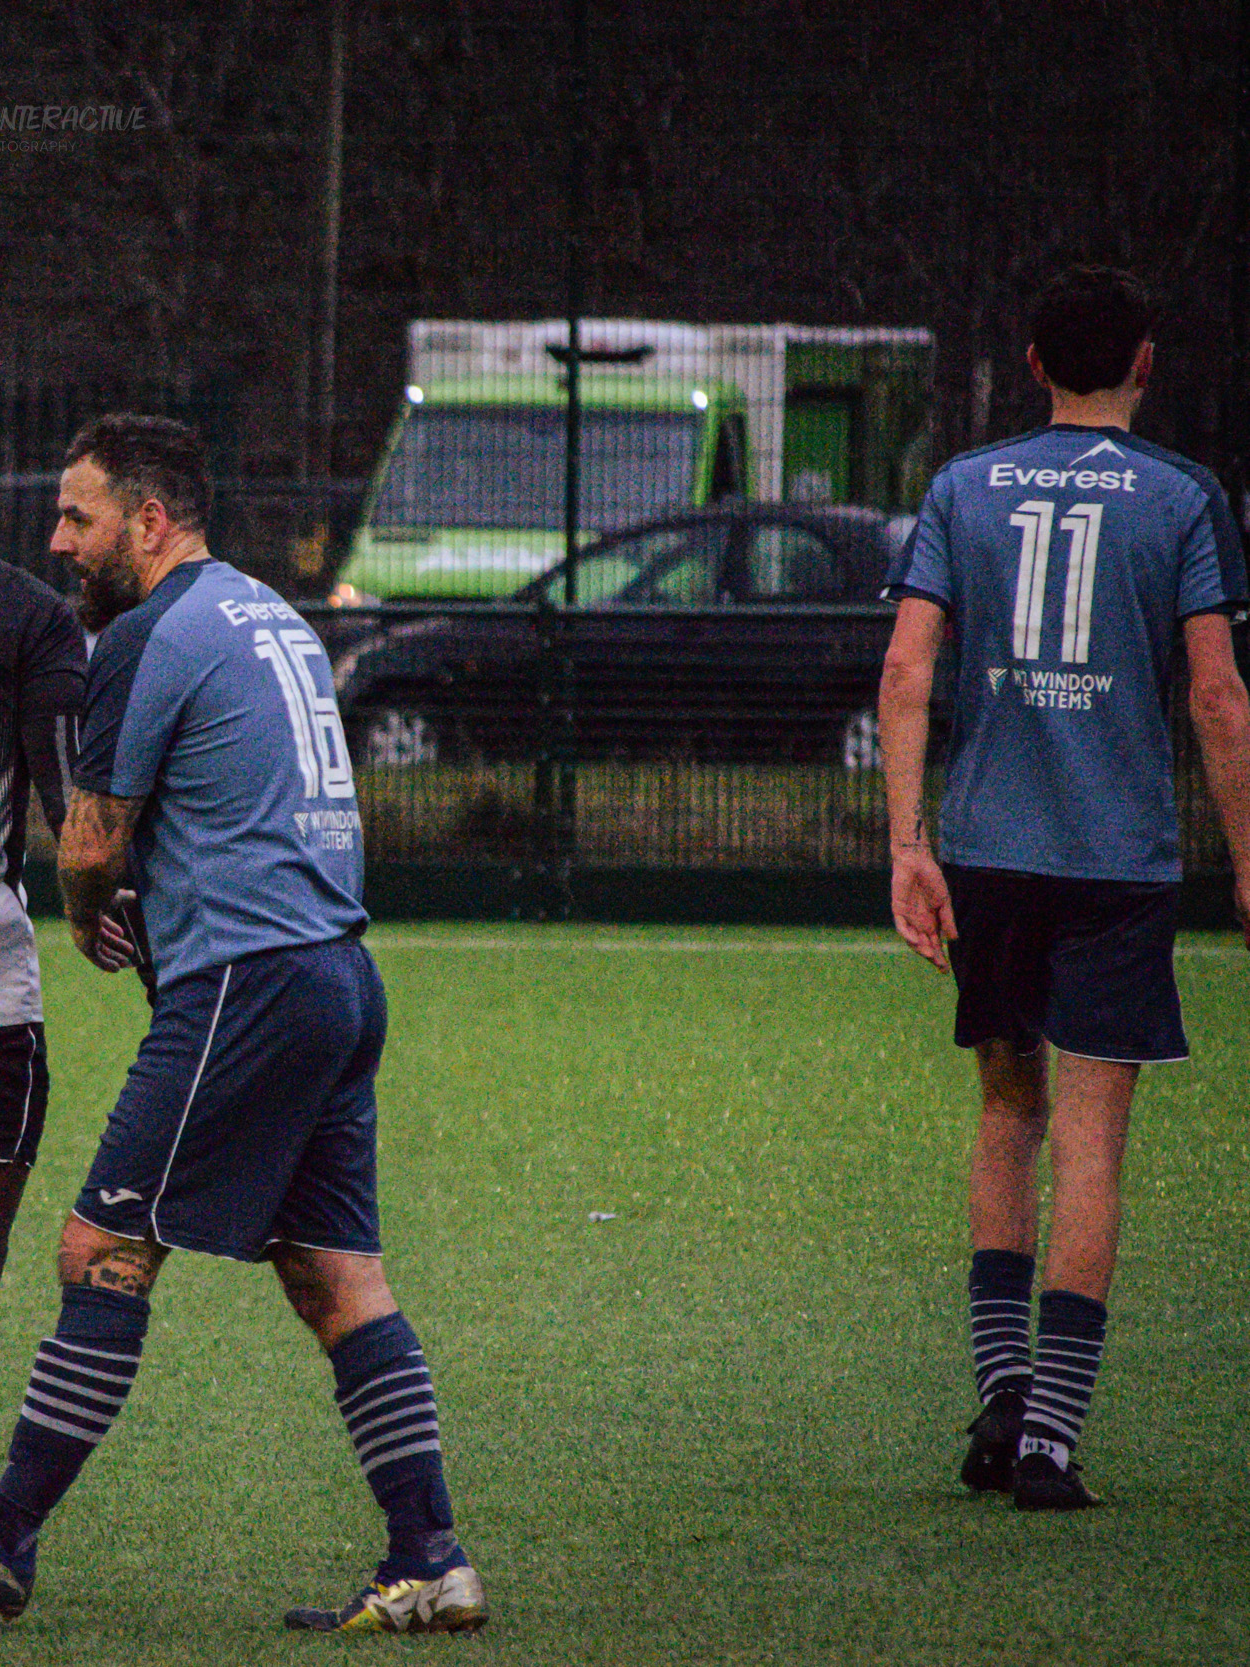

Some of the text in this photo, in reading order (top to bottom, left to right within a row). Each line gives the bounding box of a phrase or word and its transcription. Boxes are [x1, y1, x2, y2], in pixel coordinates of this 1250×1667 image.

[989, 463, 1137, 492] Everest
[1010, 500, 1103, 663] 11
[1031, 671, 1113, 693] WINDOW
[254, 629, 356, 798] 16
[1024, 689, 1092, 710] SYSTEMS
